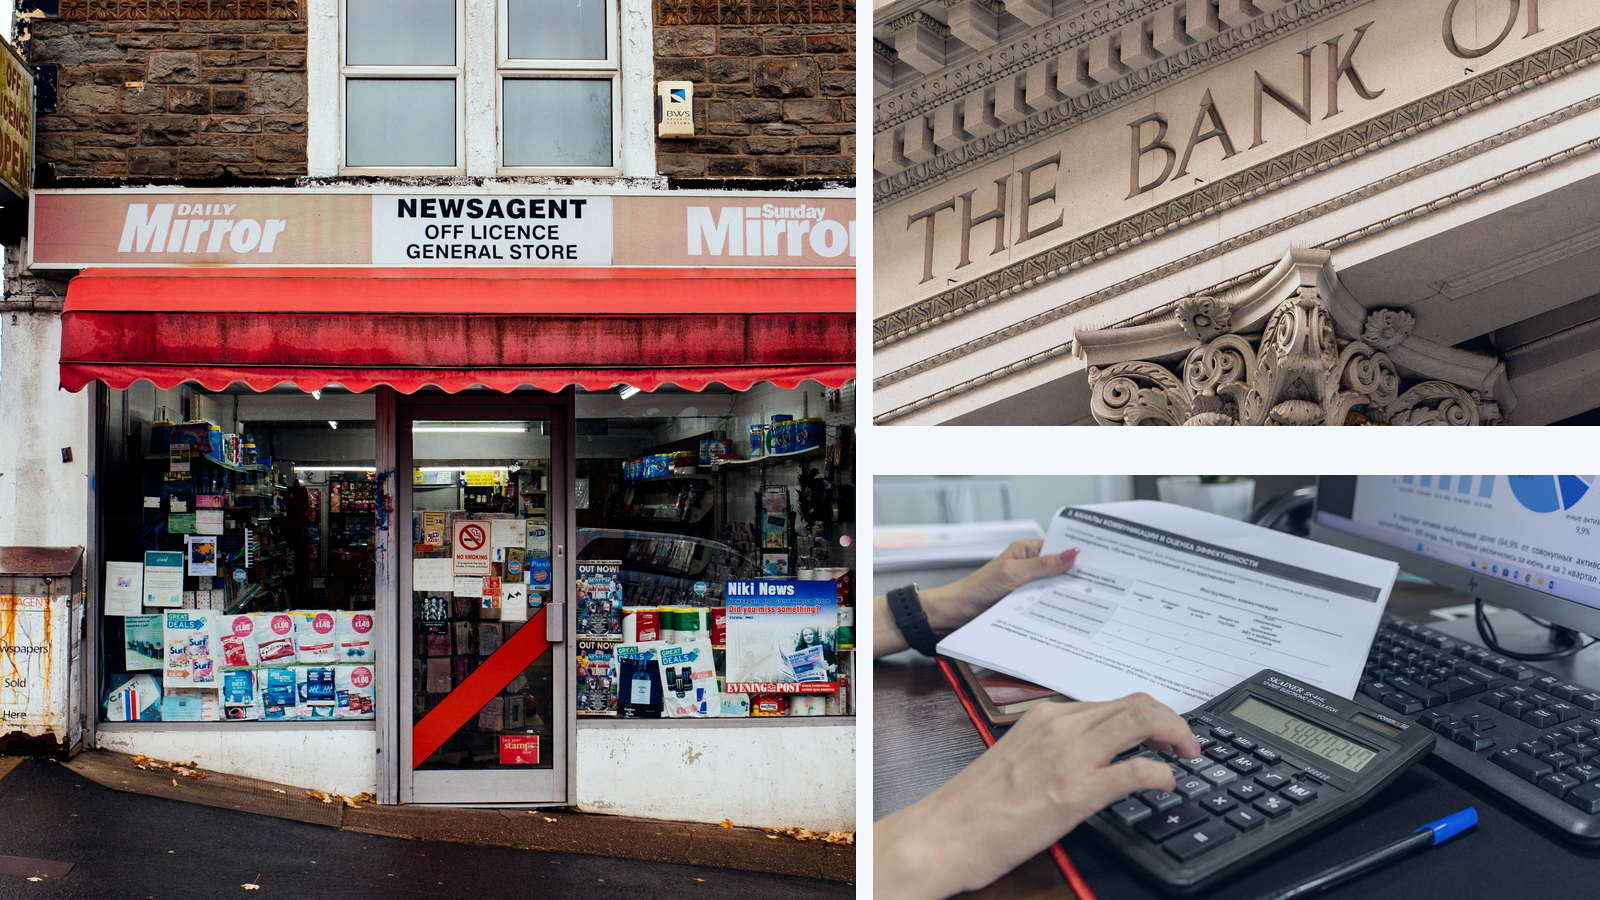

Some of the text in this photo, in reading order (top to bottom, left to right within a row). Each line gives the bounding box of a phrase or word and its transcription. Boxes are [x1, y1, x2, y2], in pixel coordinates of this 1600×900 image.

[6, 62, 21, 96] OFF
[906, 149, 1066, 285] THE
[1123, 20, 1386, 201] BANK
[177, 203, 237, 216] DAILY
[396, 198, 587, 219] NEWSAGENT
[761, 203, 826, 221] Sunday
[117, 203, 287, 254] Mirror
[424, 224, 560, 241] OFF LICENCE
[405, 243, 578, 260] GENERAL STORE
[1566, 513, 1582, 522] иные
[1575, 525, 1591, 536] 9,9%
[1166, 536, 1194, 551] ОЦЕНКА
[1195, 544, 1259, 569] ЭФФЕКТИВНОСТИ
[1531, 547, 1573, 563] совокупных
[579, 565, 619, 573] OUT NOW!
[1526, 559, 1544, 569] июнь
[1552, 565, 1561, 573] за
[1561, 566, 1566, 574] 2
[1567, 570, 1597, 583] квартал
[728, 582, 795, 596] Niki News
[1200, 586, 1278, 613] Инструменты коммуникаций
[728, 605, 741, 613] Did
[758, 605, 775, 613] miss
[777, 605, 820, 615] something?
[274, 621, 289, 629] £1.00
[315, 620, 331, 628] £1.49
[354, 620, 370, 628] £1.49
[189, 638, 207, 646] Surf
[579, 641, 596, 649] OUT
[170, 646, 187, 654] Surf
[193, 661, 211, 669] Surf
[663, 655, 689, 665] DEALS
[5, 678, 27, 688] Sold
[353, 676, 369, 684] £1.00
[1153, 673, 1189, 690] предлагается
[1267, 676, 1304, 694] SKAINER
[727, 682, 800, 693] EVENING POST
[1157, 681, 1181, 693] схожими
[1279, 688, 1309, 702] ELECTRONIC
[1307, 698, 1339, 713] CALCULATOR
[3, 710, 27, 720] Here
[1377, 713, 1396, 724] POWER
[504, 743, 534, 752] stamps
[1190, 757, 1203, 765] 8
[1212, 769, 1226, 777] 9
[1185, 780, 1199, 788] 6
[1288, 784, 1310, 797] MU
